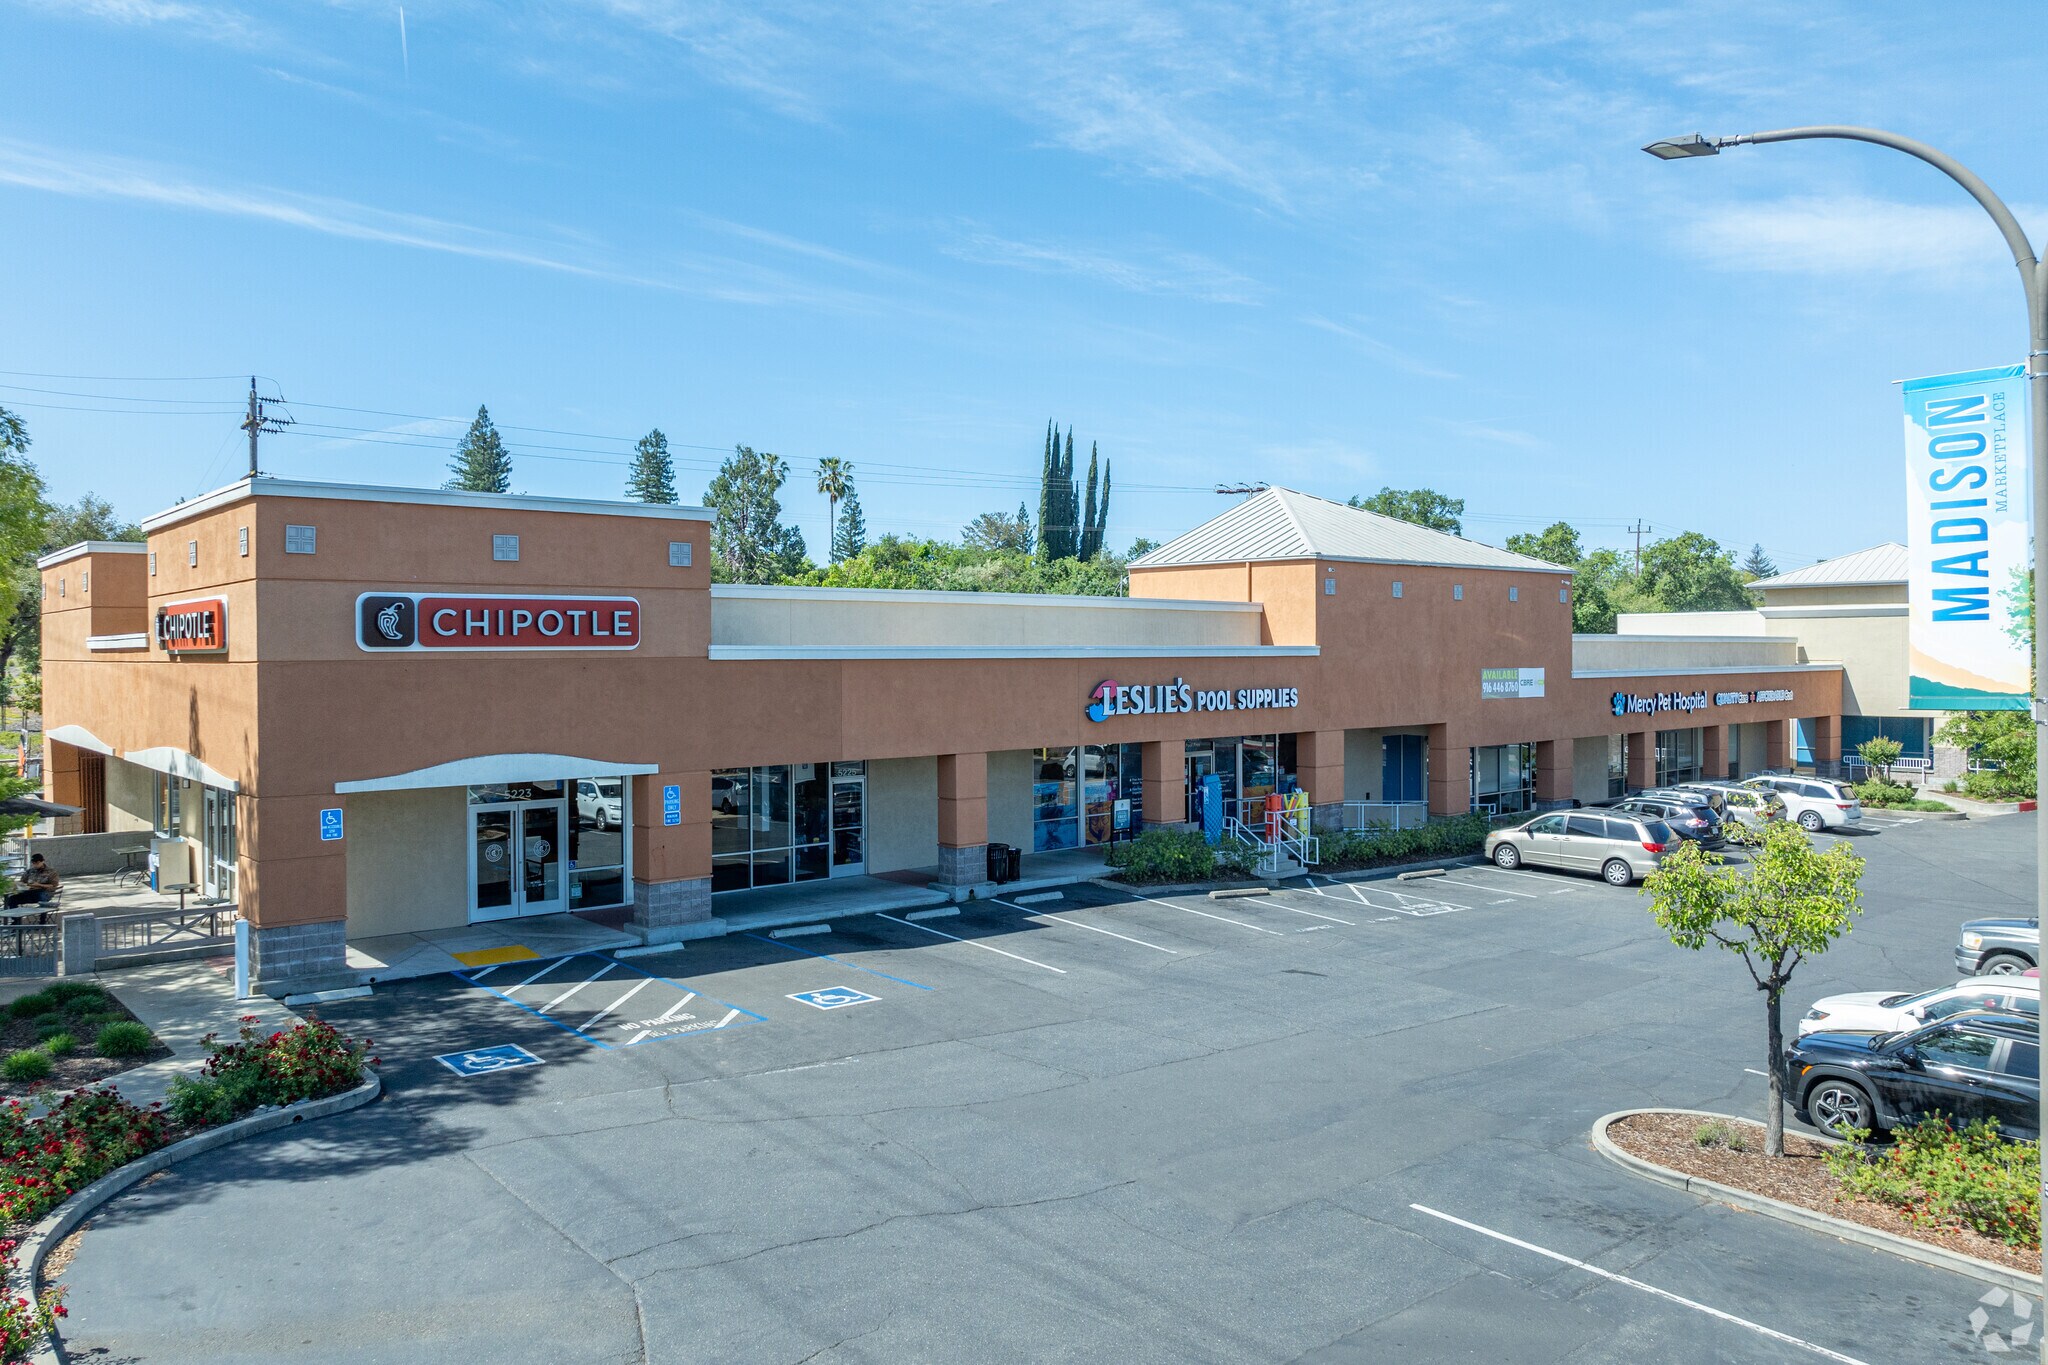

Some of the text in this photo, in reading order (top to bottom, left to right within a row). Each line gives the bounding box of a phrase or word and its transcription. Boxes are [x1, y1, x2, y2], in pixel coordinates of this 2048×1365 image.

[1993, 391, 2008, 513] MARKETPLACE
[1926, 395, 1990, 622] MADISON
[164, 611, 210, 640] CHIPOTLE
[433, 608, 632, 636] CHIPOTLE
[1482, 670, 1518, 680] AVAILABLE
[1102, 677, 1299, 716] LESLIE'S POOL SUPPLIES
[1627, 690, 1708, 716] Mercy Pet Hospital
[504, 788, 532, 800] 5223
[618, 1012, 697, 1031] NO PARKING
